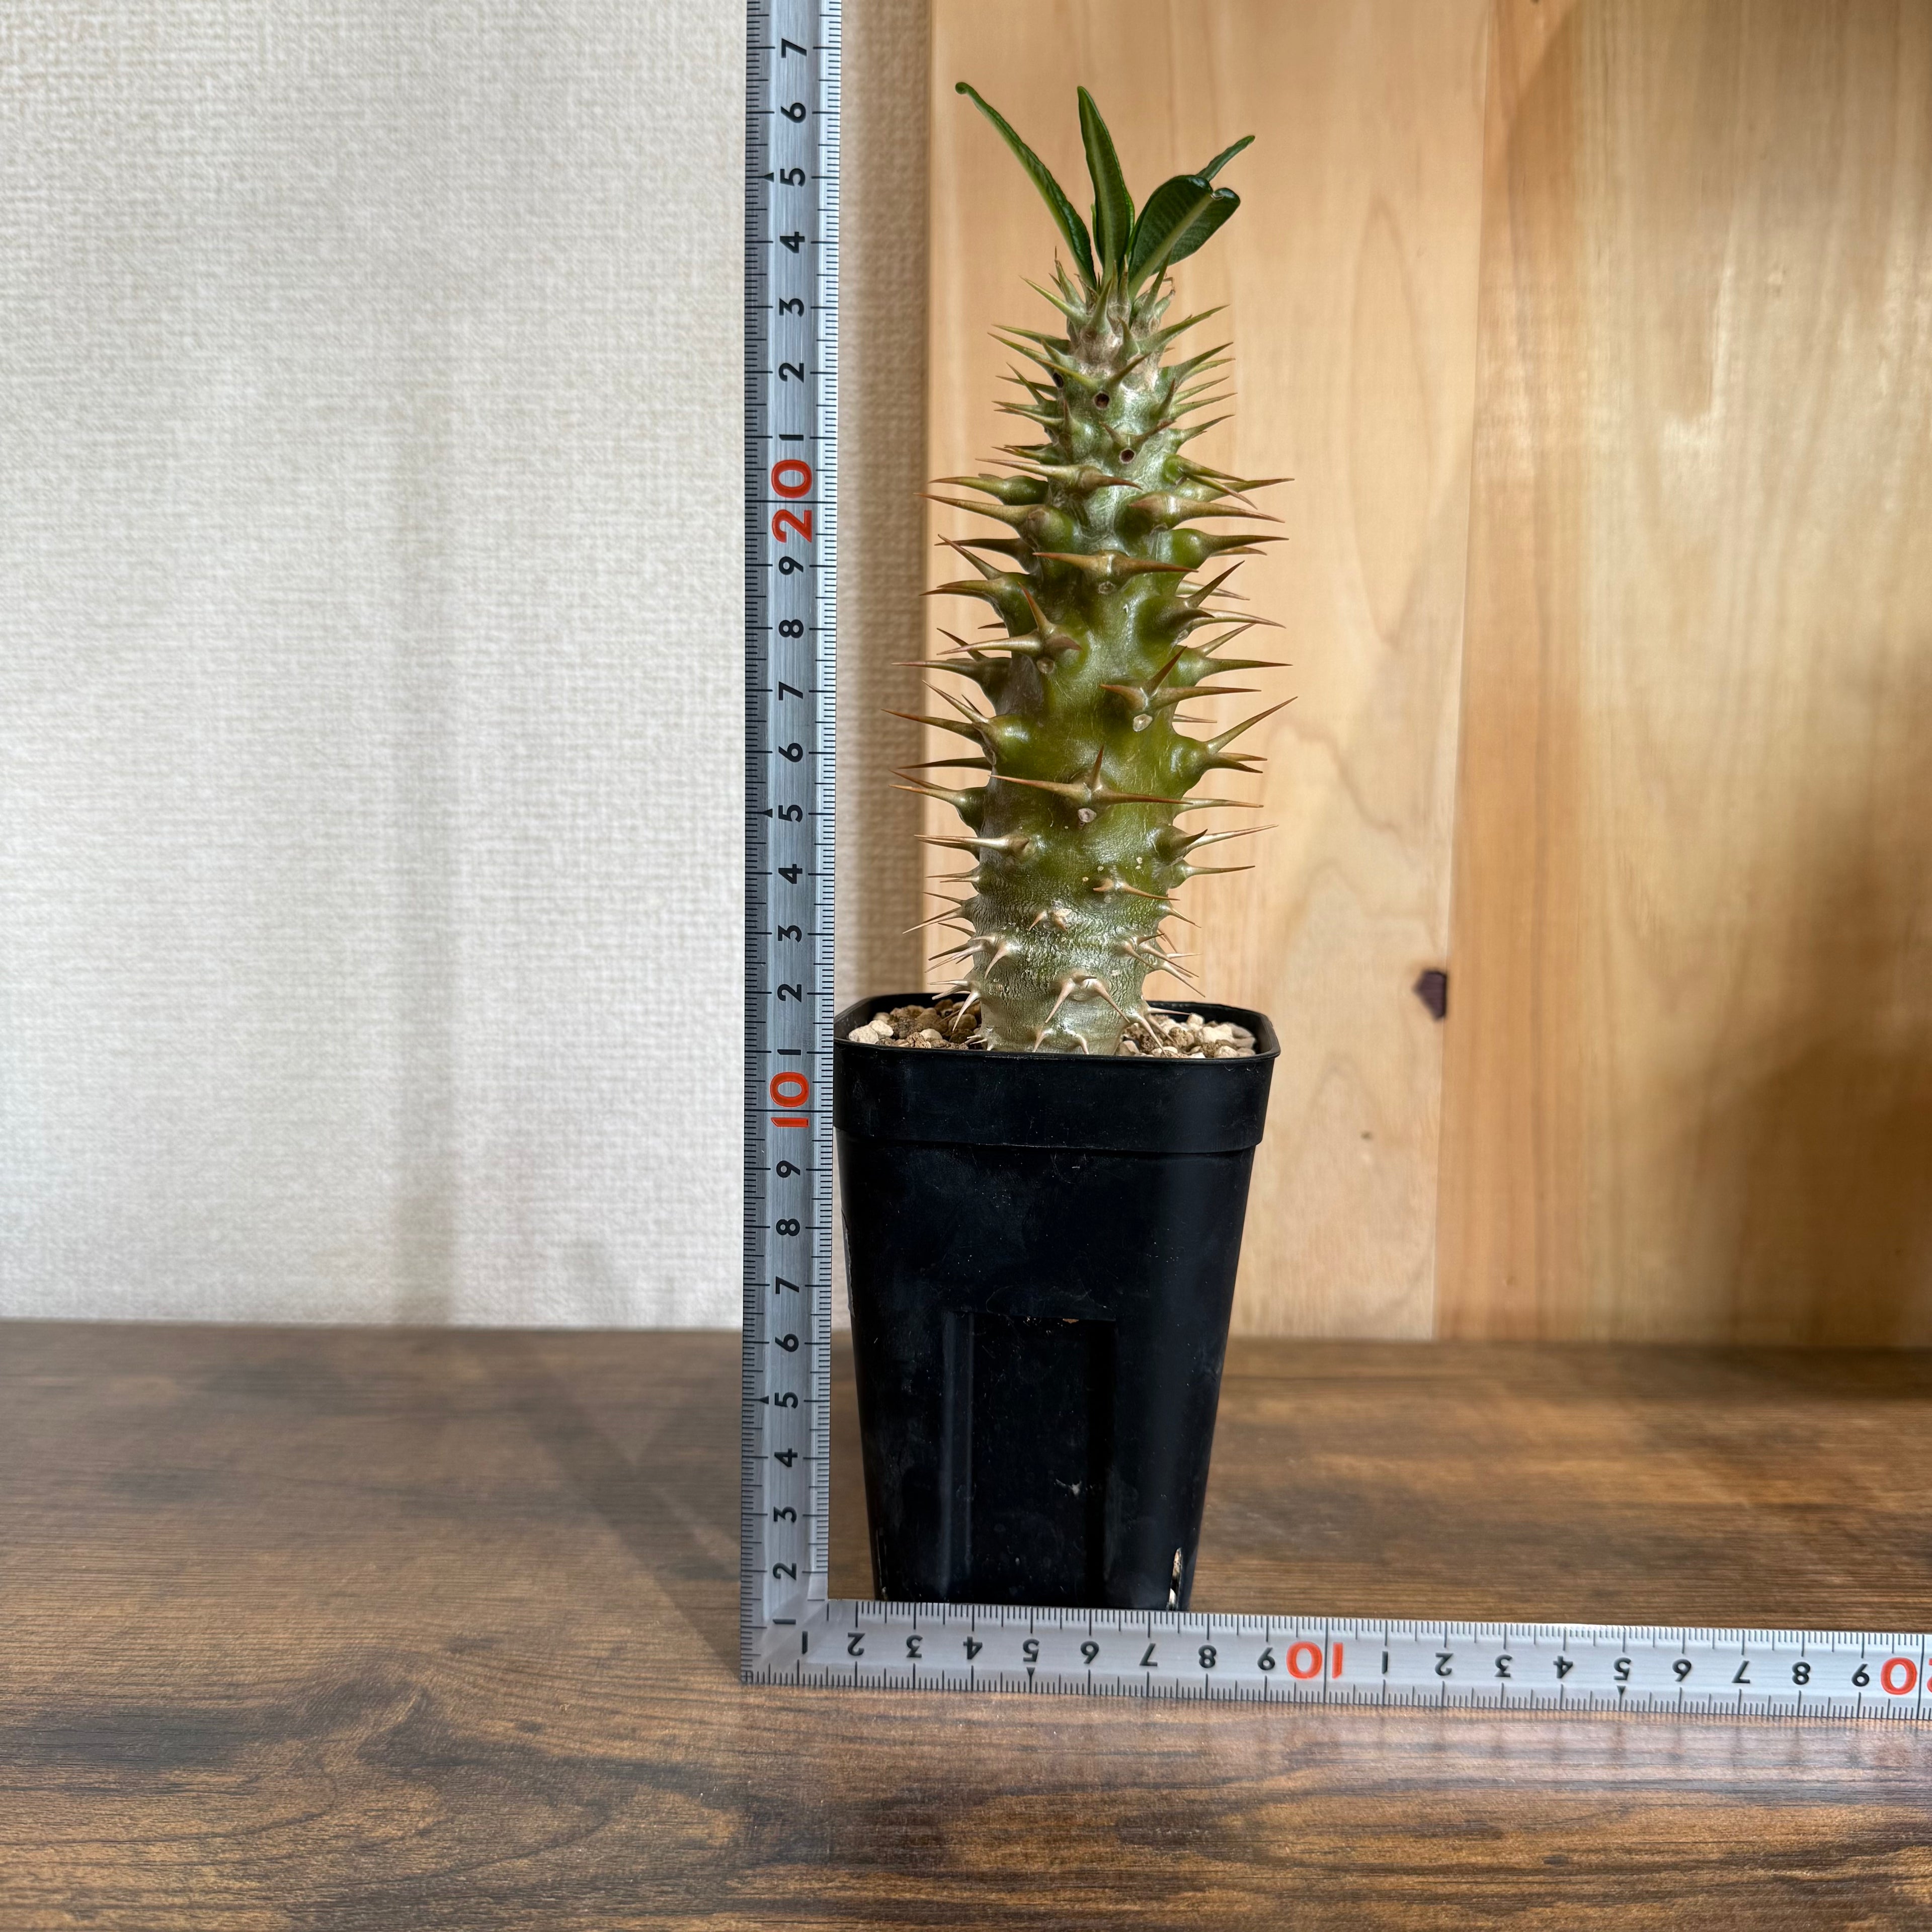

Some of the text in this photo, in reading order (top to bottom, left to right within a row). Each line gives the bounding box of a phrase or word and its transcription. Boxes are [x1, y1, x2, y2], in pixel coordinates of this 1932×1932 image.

[781, 38, 807, 58] 7
[780, 102, 807, 123] 6
[780, 168, 806, 187] 5
[779, 231, 806, 254] 4
[779, 298, 804, 317] 3
[778, 362, 804, 383] 2
[771, 459, 813, 543] 20
[778, 556, 804, 576] 9
[778, 619, 804, 638] 8
[778, 681, 803, 701] 7
[778, 743, 803, 763] 6
[778, 804, 803, 823] 5
[778, 863, 803, 884] 4
[777, 925, 802, 943] 3
[777, 984, 802, 1003] 2
[770, 1071, 810, 1129] 10
[776, 1160, 801, 1178] 9
[775, 1218, 800, 1237] 8
[775, 1276, 800, 1295] 7
[774, 1333, 799, 1353] 6
[774, 1392, 799, 1409] 5
[774, 1447, 798, 1469] 4
[773, 1506, 797, 1525] 3
[772, 1562, 797, 1581] 2
[801, 1631, 808, 1655] 1
[847, 1632, 865, 1657] 2
[906, 1635, 923, 1658] 3
[963, 1636, 983, 1660] 4
[1023, 1639, 1039, 1662] 5
[1080, 1641, 1099, 1664] 6
[1140, 1643, 1158, 1667] 7
[1198, 1645, 1217, 1669] 8
[1257, 1648, 1275, 1671] 9
[1285, 1642, 1343, 1680] 10
[1382, 1652, 1388, 1674] 1
[1435, 1653, 1453, 1677] 2
[1495, 1655, 1512, 1678] 3
[1554, 1656, 1574, 1679] 4
[1614, 1658, 1632, 1681] 5
[1672, 1659, 1692, 1682] 6
[1733, 1661, 1751, 1684] 7
[1793, 1662, 1811, 1686] 8
[1852, 1663, 1870, 1687] 9
